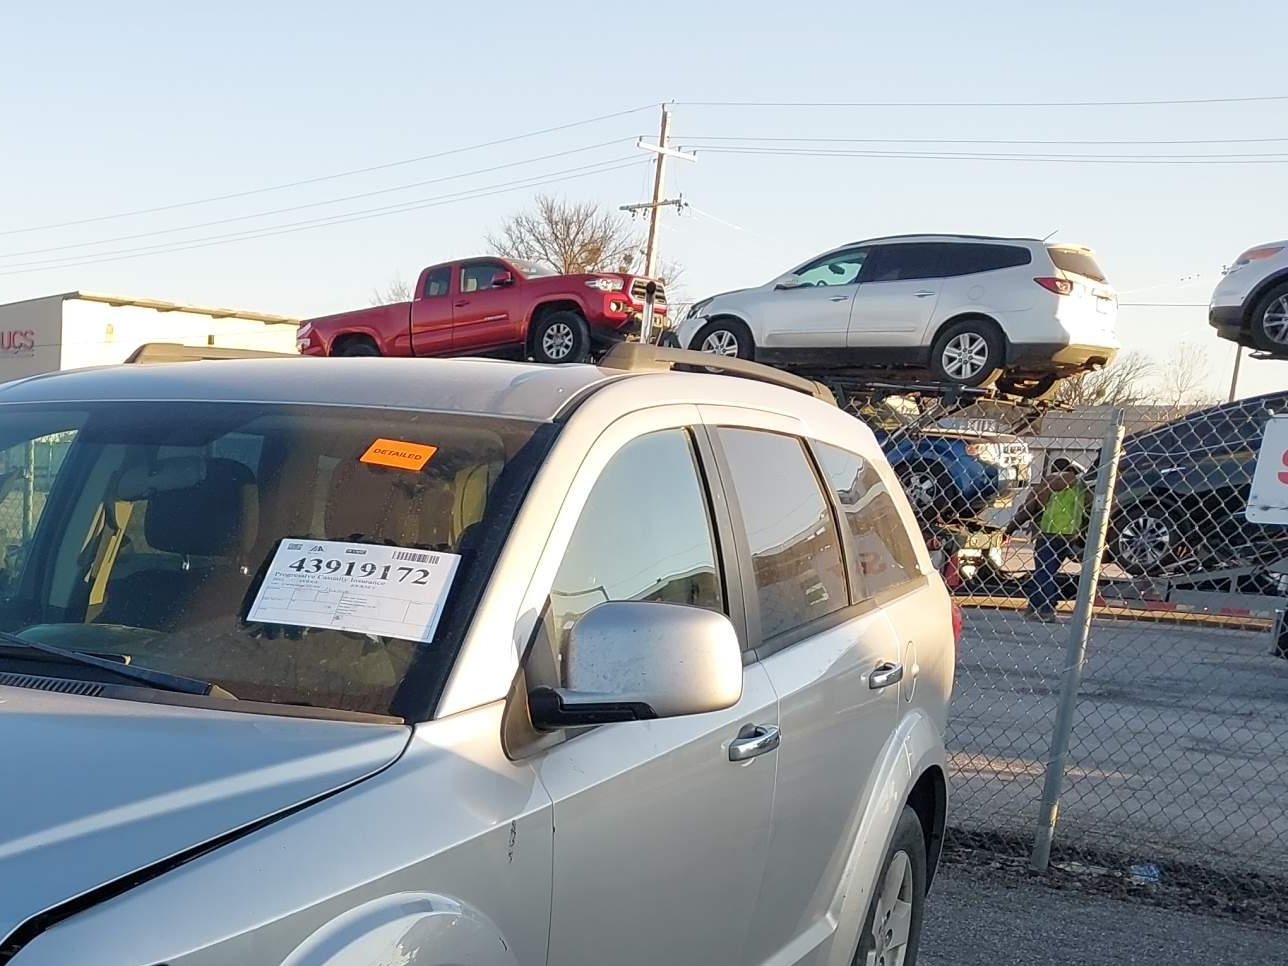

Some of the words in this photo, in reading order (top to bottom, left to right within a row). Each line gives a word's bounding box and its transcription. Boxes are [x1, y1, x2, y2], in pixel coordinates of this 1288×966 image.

[0, 330, 34, 350] UCS
[373, 448, 422, 460] DETAILED
[274, 571, 315, 580] Progressive
[317, 574, 348, 583] Casualty
[350, 577, 386, 586] Insurance
[288, 557, 430, 585] 43919172
